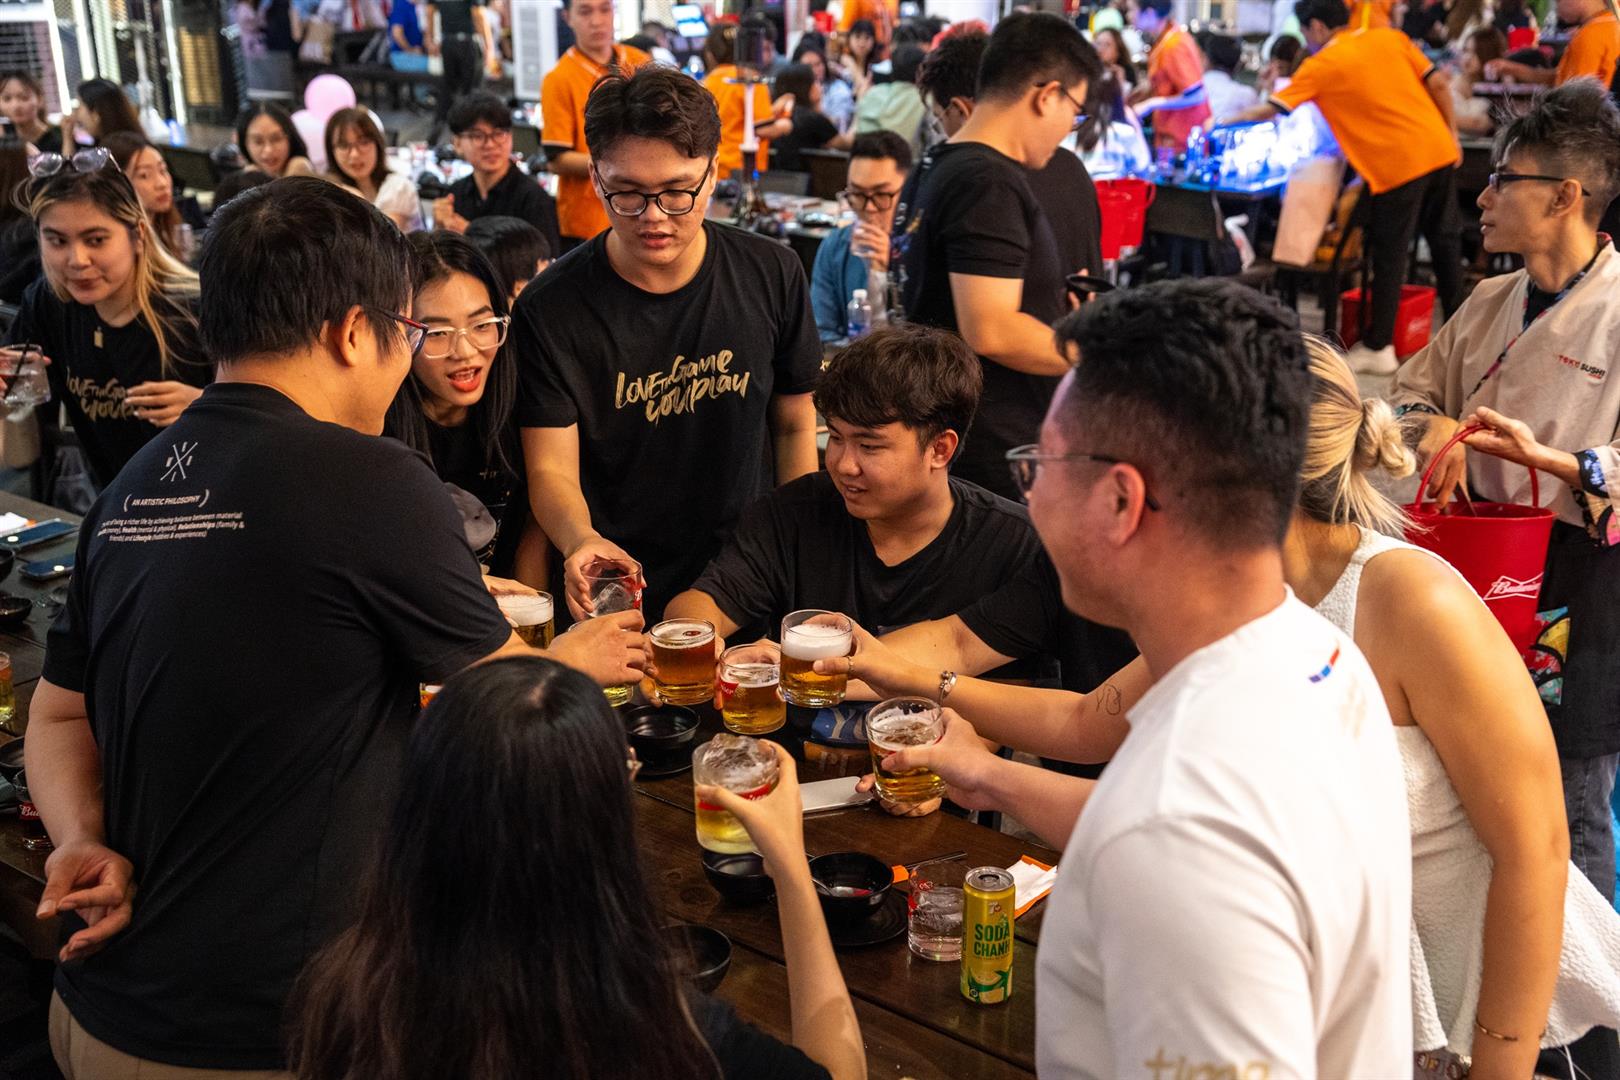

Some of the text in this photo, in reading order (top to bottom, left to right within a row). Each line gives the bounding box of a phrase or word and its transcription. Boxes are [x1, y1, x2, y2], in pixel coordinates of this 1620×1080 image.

[131, 495, 201, 506] AN ARTISTIC PHILOSOPHY
[173, 515, 193, 524] balance
[192, 513, 216, 522] between
[215, 511, 243, 520] material
[177, 521, 216, 531] Relationships
[238, 520, 245, 529] &
[974, 923, 1010, 943] SODA
